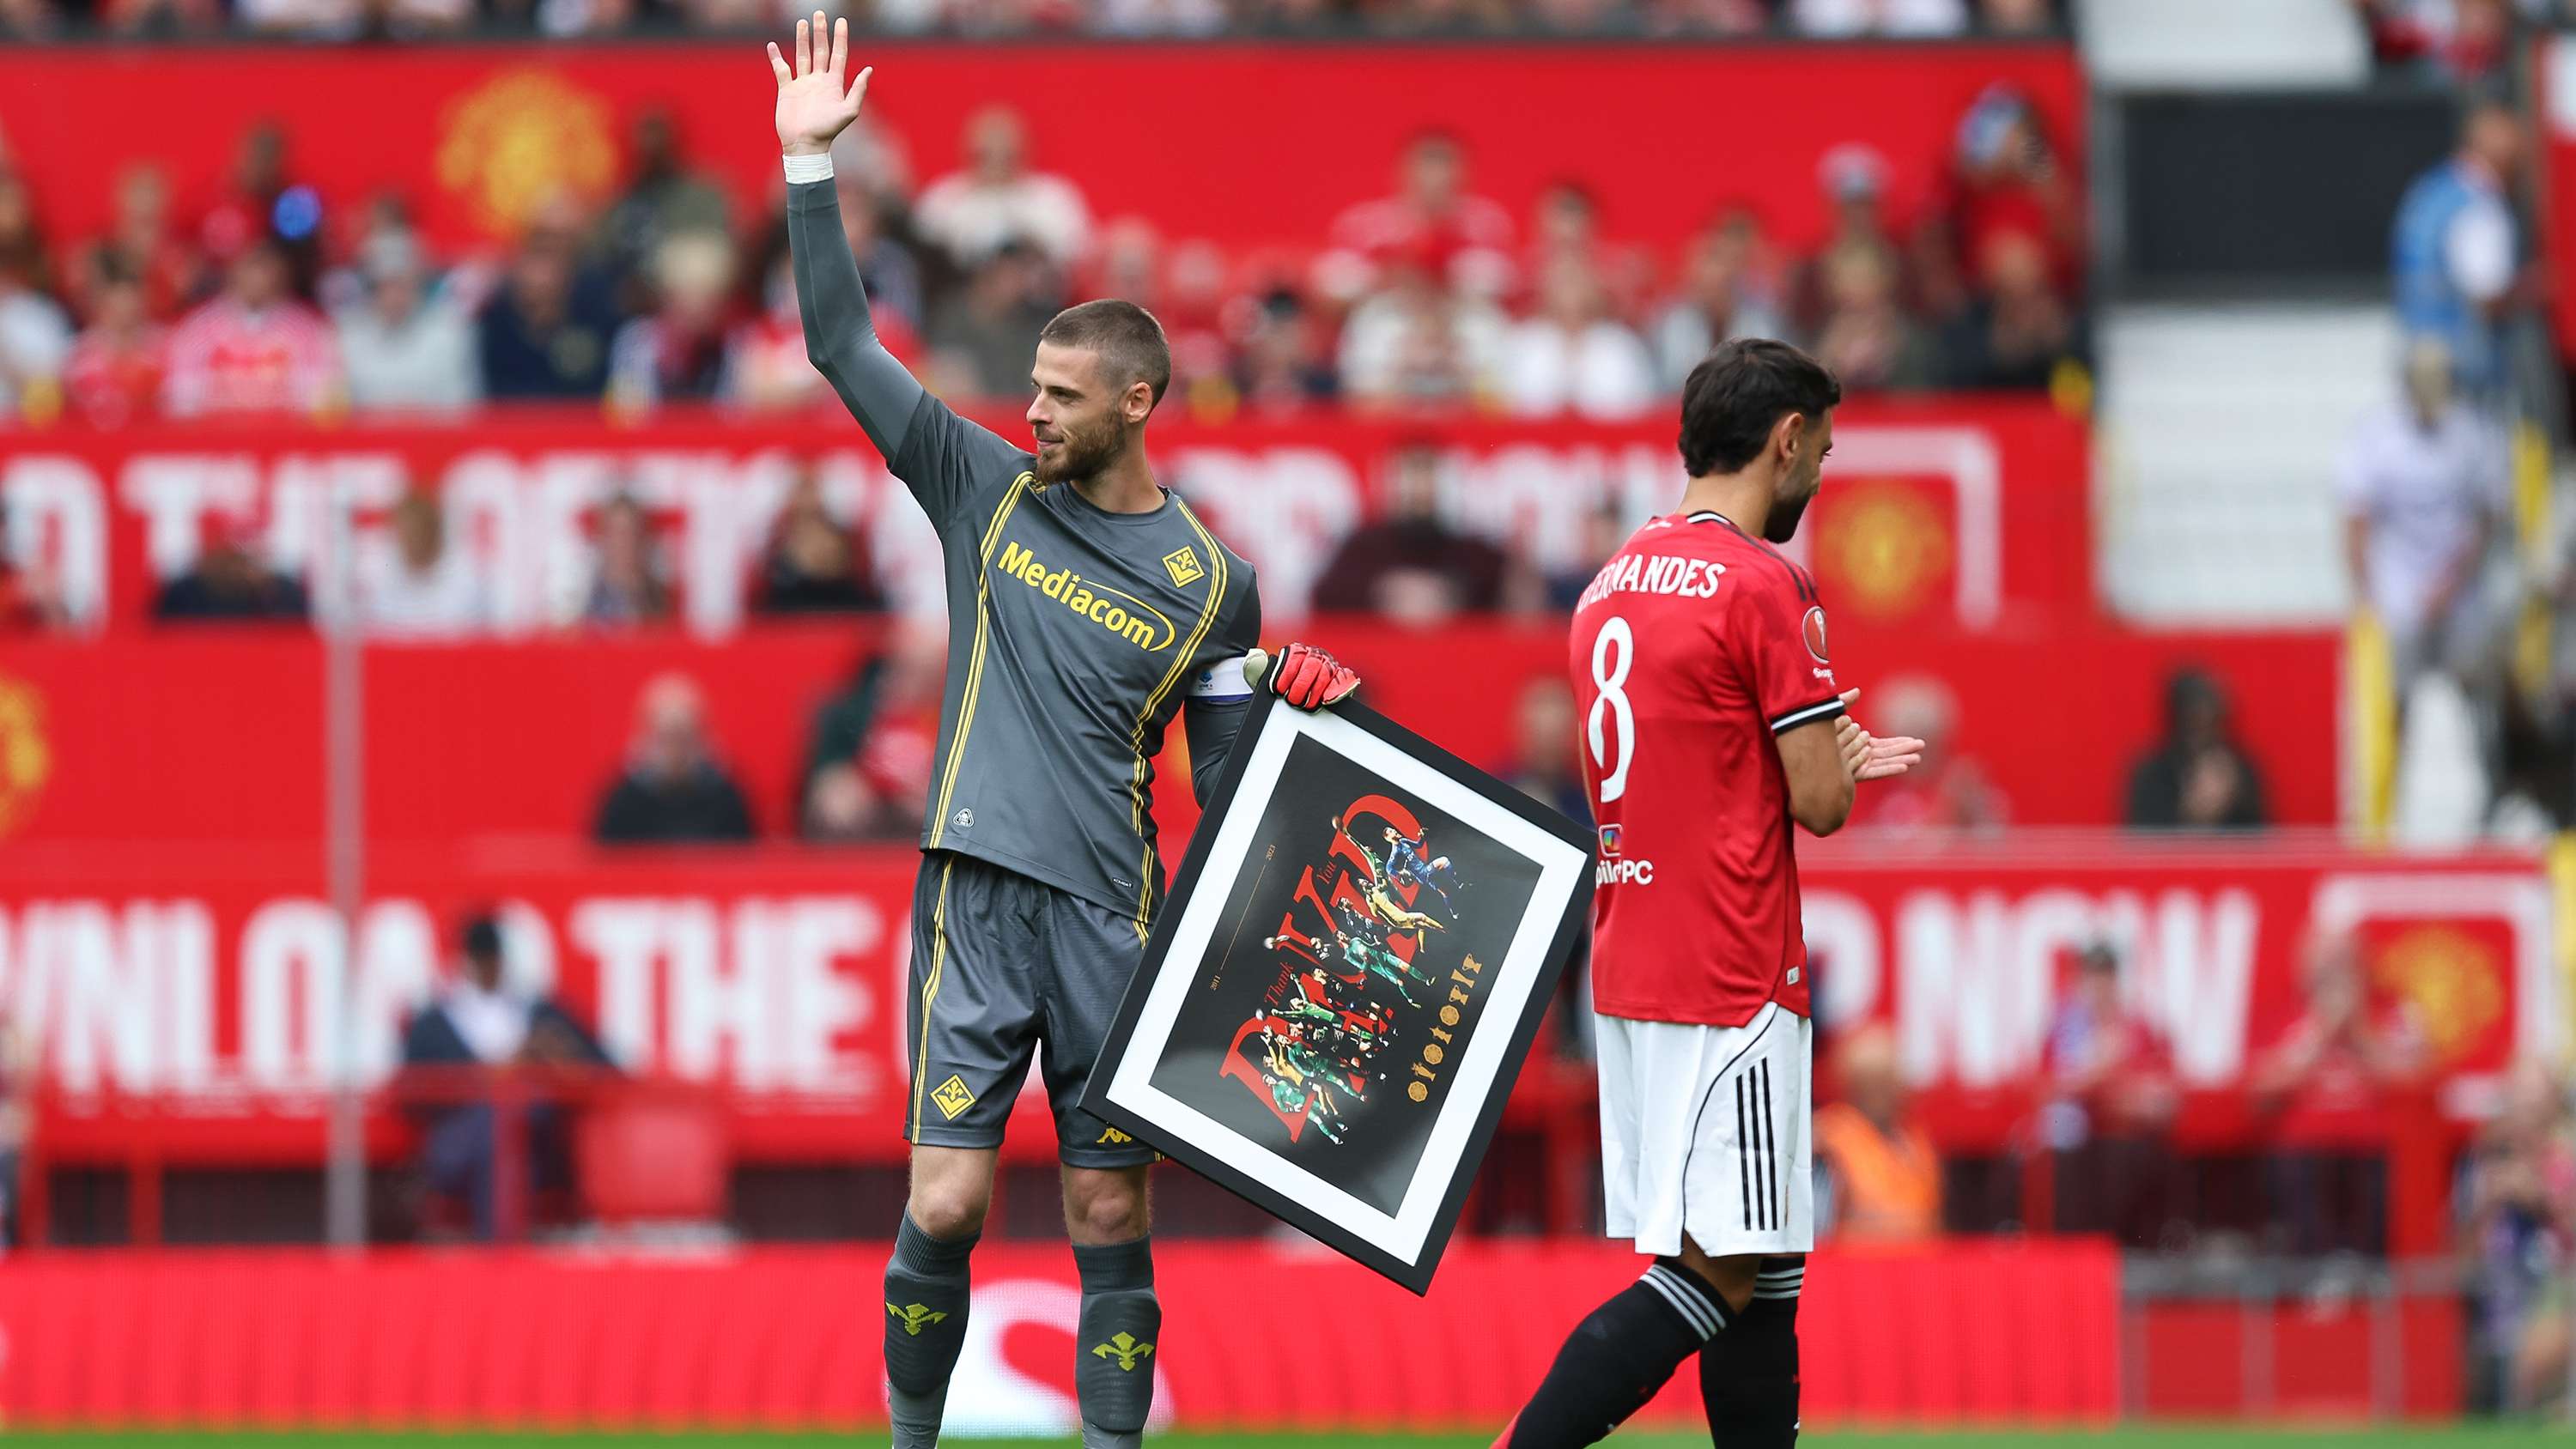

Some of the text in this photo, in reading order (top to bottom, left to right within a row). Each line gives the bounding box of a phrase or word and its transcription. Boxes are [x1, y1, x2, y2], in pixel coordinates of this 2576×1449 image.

[997, 541, 1156, 651] Mediacom
[1588, 615, 1635, 803] 8
[570, 895, 883, 1092] THE
[1264, 860, 1338, 1007] Thank You
